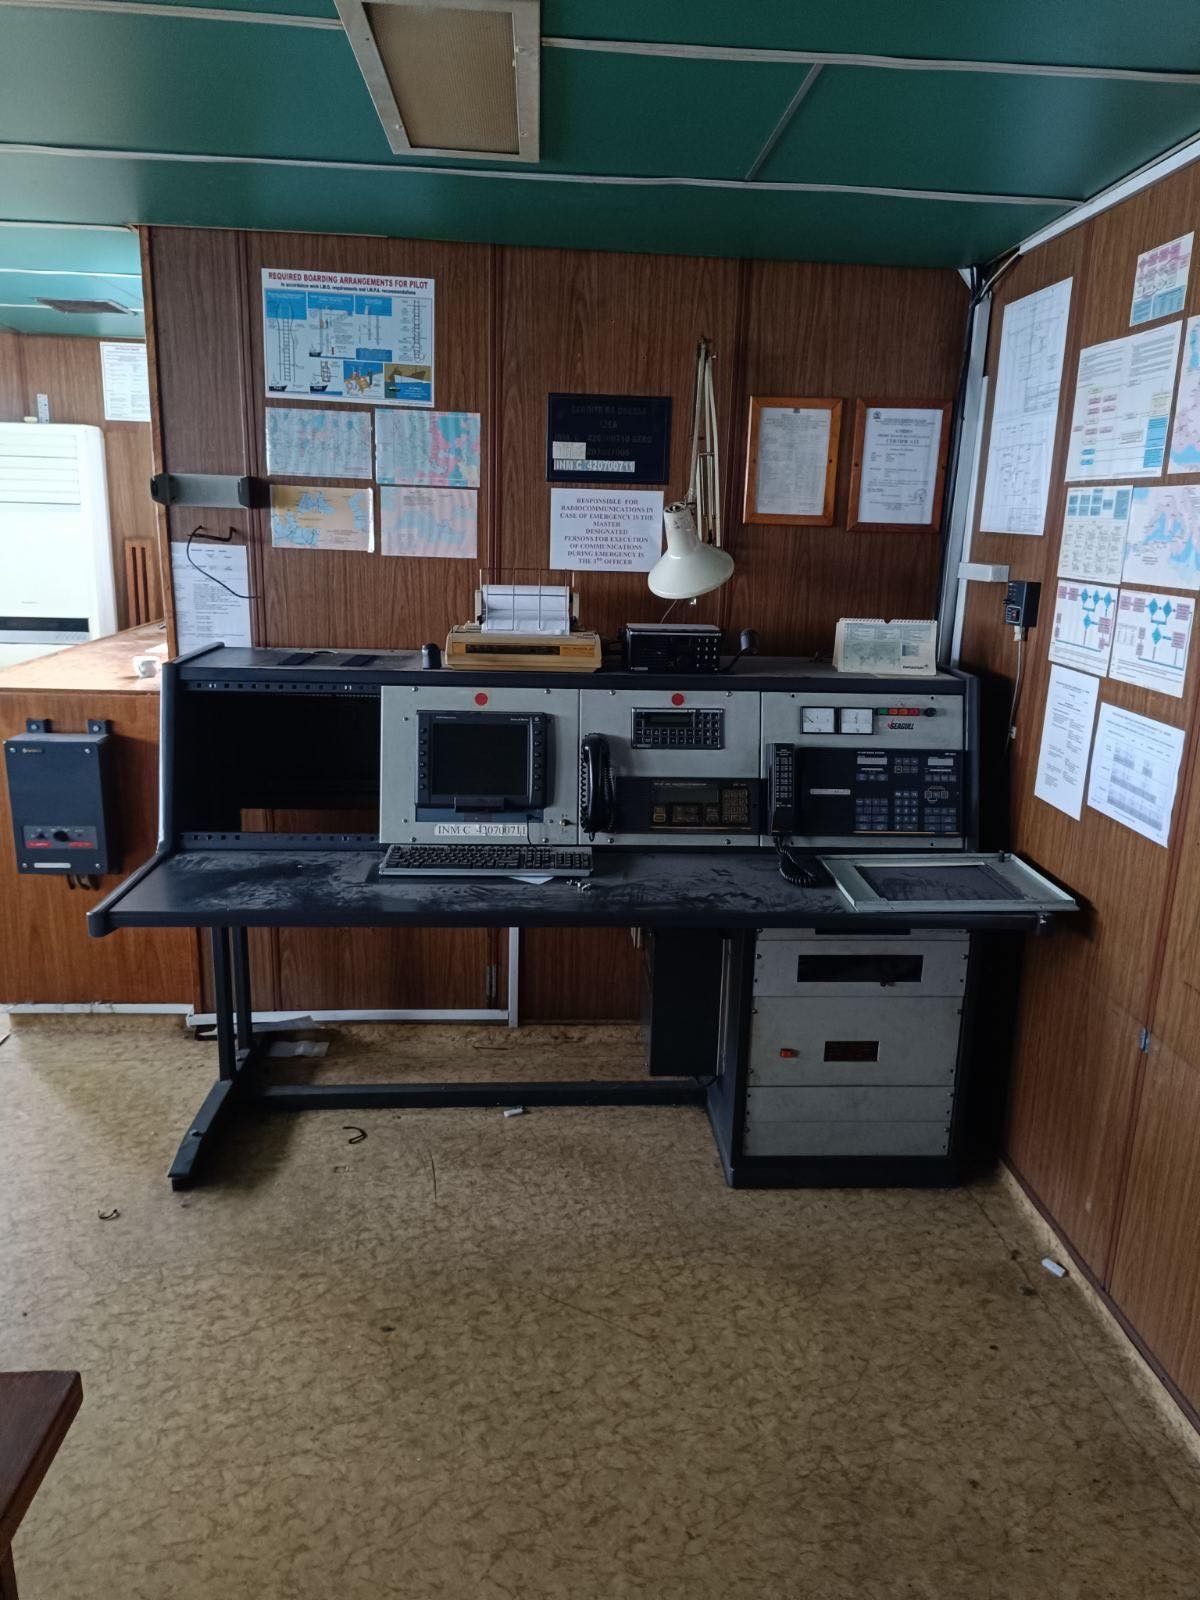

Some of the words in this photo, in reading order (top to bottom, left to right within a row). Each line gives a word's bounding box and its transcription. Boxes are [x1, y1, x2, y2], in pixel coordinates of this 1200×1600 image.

[268, 271, 302, 281] REQUIRED
[303, 273, 338, 284] BOARDING
[339, 276, 393, 288] ARRANGEMENTS
[394, 280, 408, 288] FOR
[409, 281, 429, 290] PILOT
[561, 505, 645, 513] RADIOCOMMUNICATIONS
[463, 826, 470, 834] C
